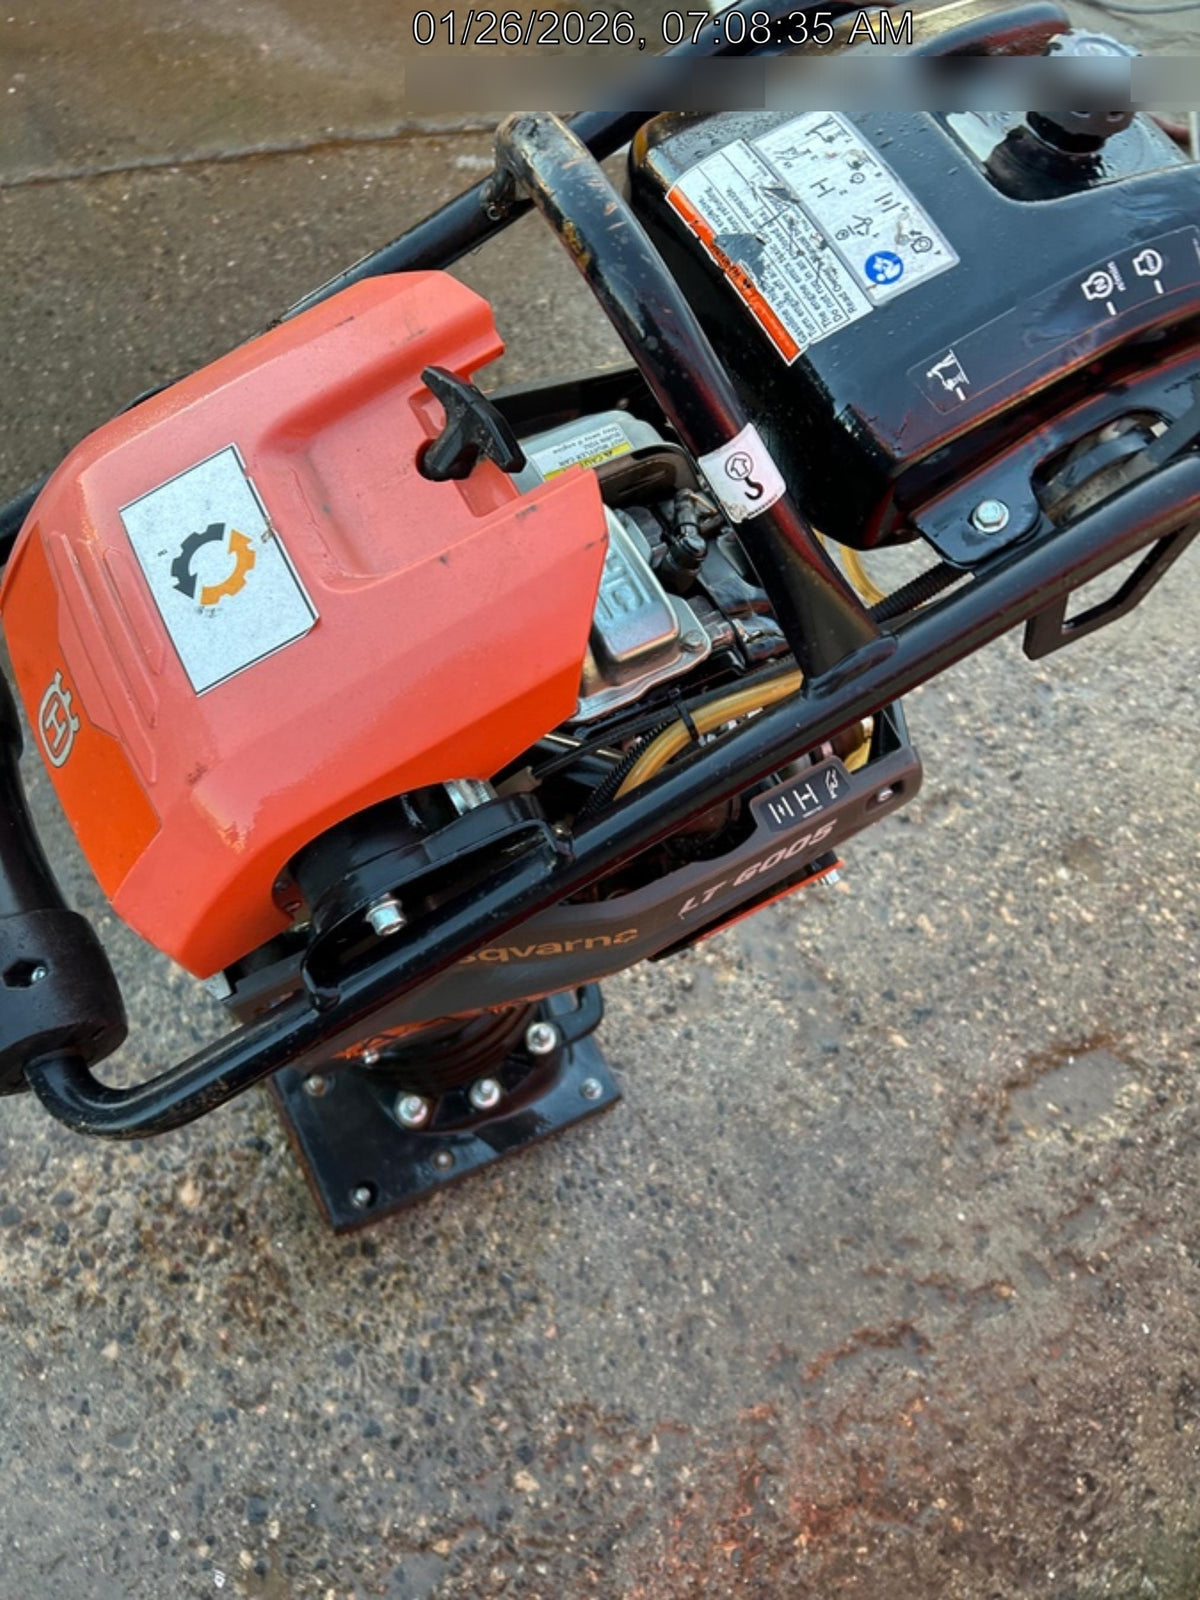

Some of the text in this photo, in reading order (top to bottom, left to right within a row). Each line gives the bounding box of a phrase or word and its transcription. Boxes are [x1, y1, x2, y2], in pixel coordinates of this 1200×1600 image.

[801, 270, 813, 281] in
[796, 281, 822, 312] engine
[836, 289, 858, 314] Read
[778, 308, 808, 344] Gasoline
[815, 310, 832, 328] The
[827, 307, 843, 323] Do
[733, 818, 837, 886] 6005
